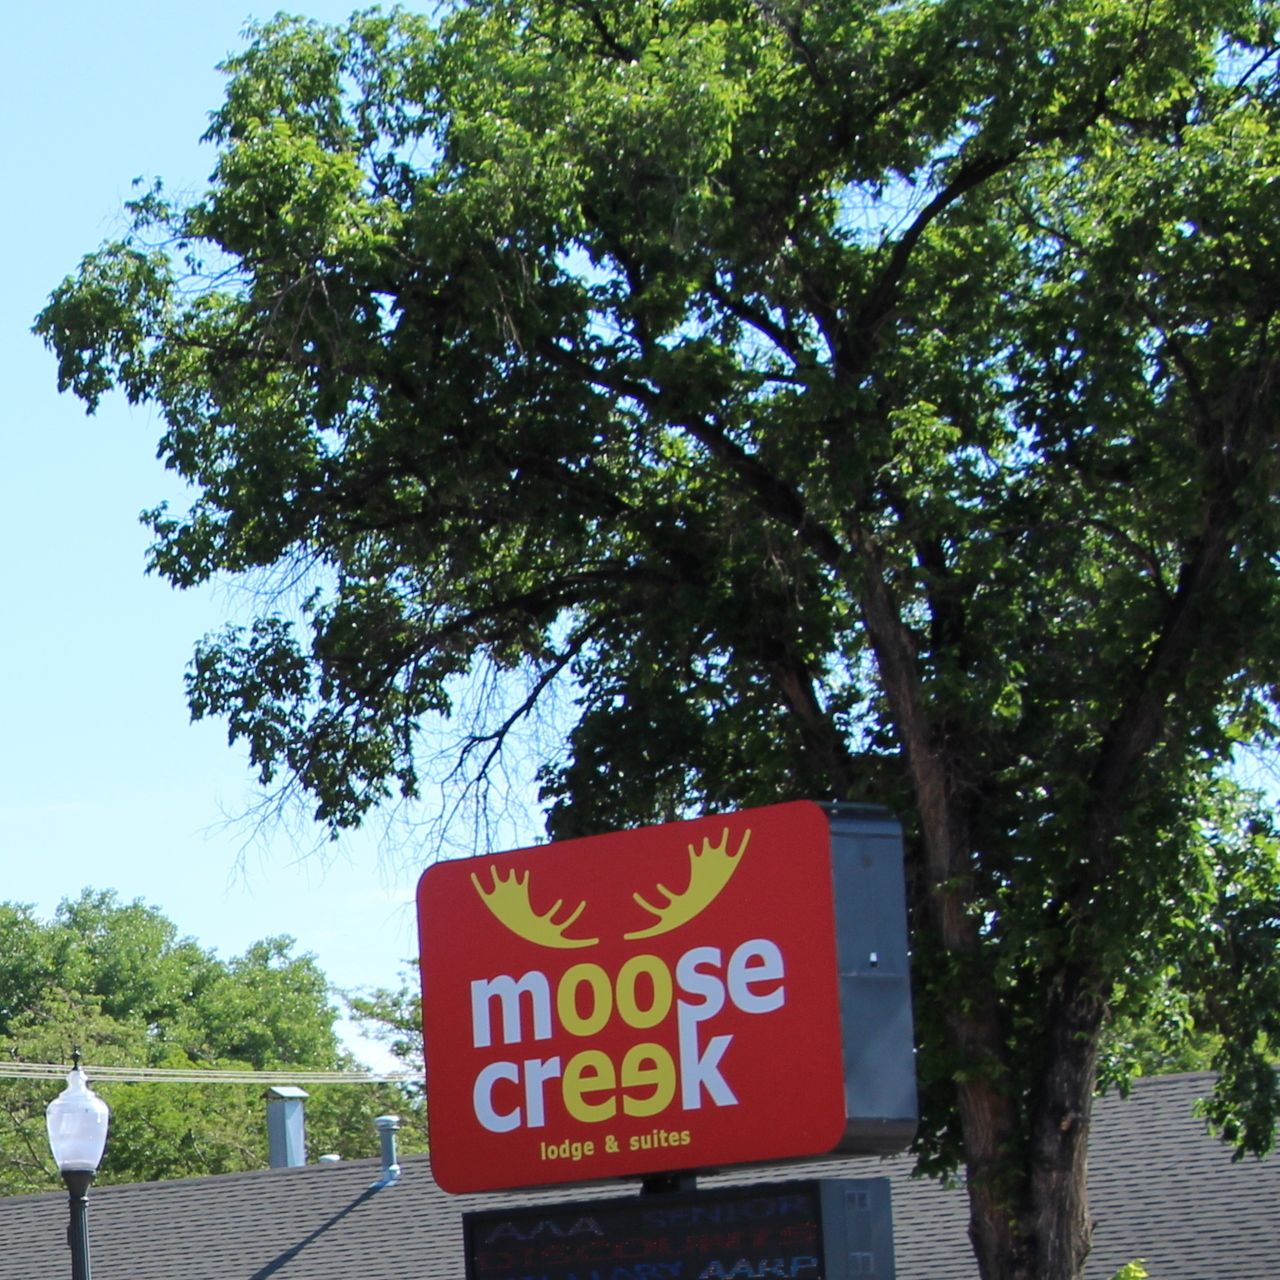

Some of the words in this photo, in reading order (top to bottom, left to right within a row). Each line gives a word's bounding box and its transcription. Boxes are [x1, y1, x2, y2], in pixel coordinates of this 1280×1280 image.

[470, 938, 785, 1048] moose
[473, 1010, 738, 1133] creek
[540, 1136, 594, 1162] lodge
[605, 1134, 619, 1155] &
[629, 1127, 691, 1152] suites
[484, 1216, 605, 1244] AAA
[643, 1195, 810, 1229] SENIOR
[698, 1255, 818, 1280] AARP
